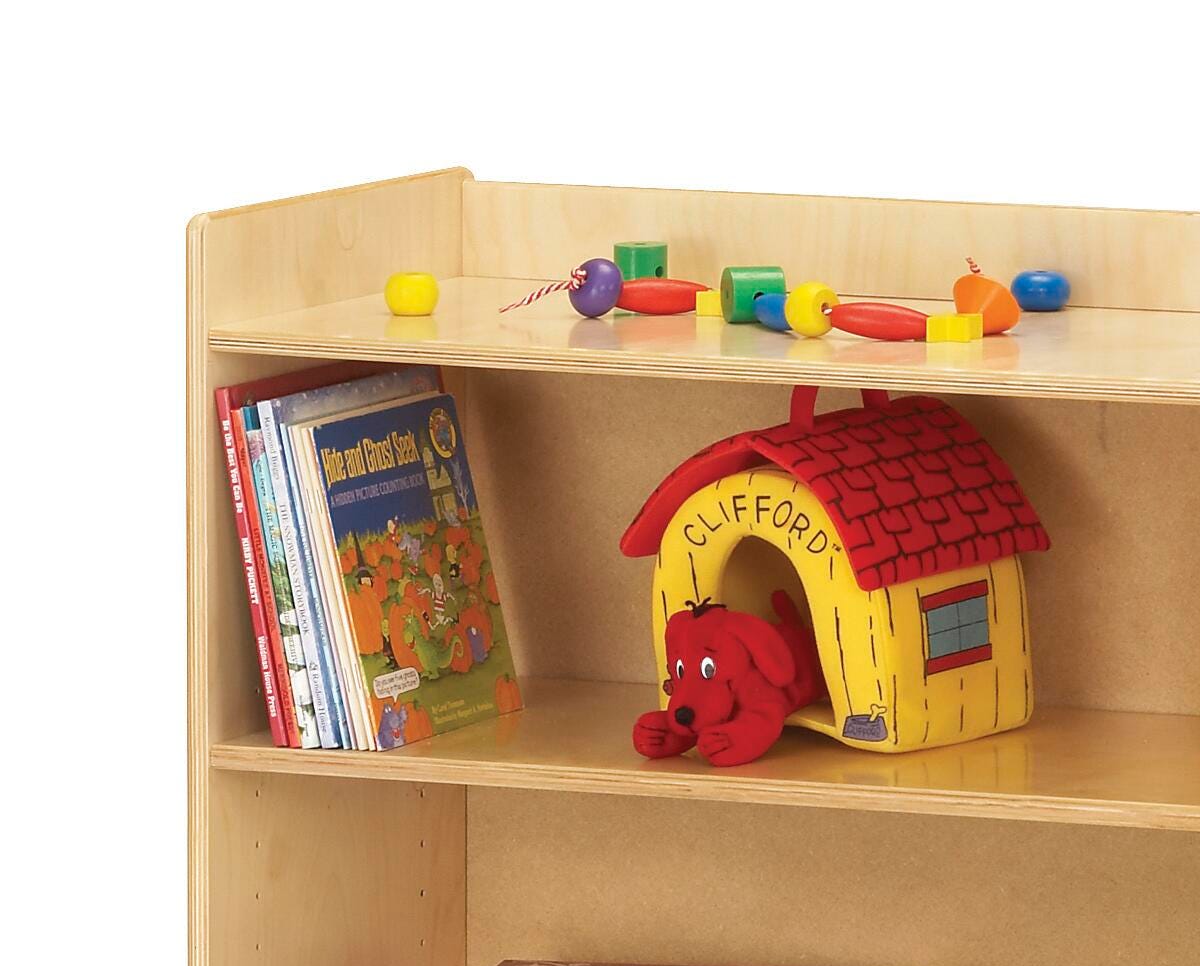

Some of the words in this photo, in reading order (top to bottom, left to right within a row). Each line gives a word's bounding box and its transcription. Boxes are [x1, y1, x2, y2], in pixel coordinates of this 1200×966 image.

[221, 419, 229, 431] Be
[224, 433, 232, 447] the
[226, 447, 236, 467] Best
[320, 446, 346, 490] Hide
[344, 441, 366, 478] and
[362, 434, 397, 474] Ghost
[391, 429, 421, 466] Seek
[229, 466, 239, 484] You
[232, 484, 242, 501] Can
[236, 502, 244, 513] Be
[684, 495, 828, 555] CLIFFORD
[263, 671, 273, 694] House
[267, 695, 277, 718] Press
